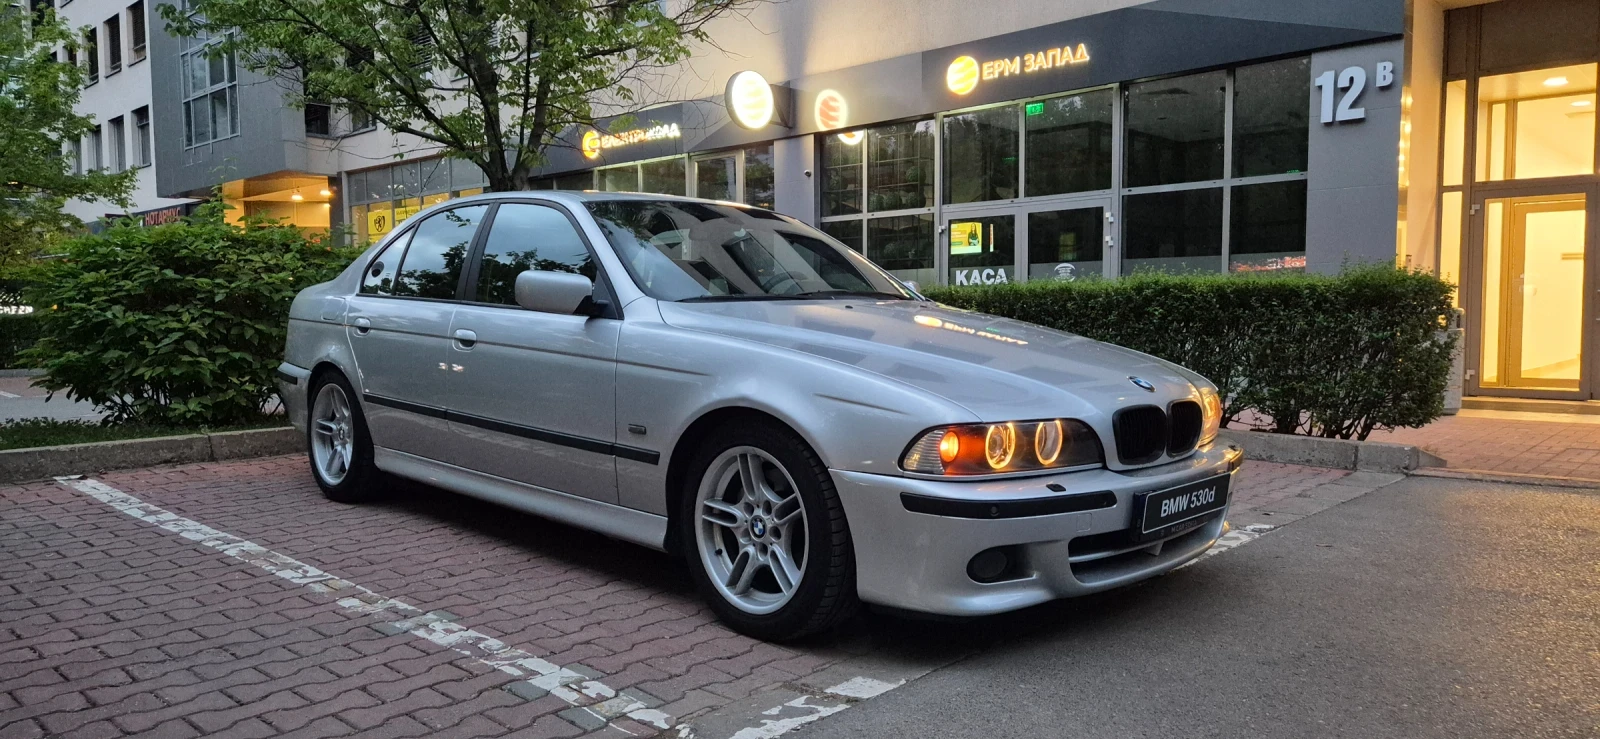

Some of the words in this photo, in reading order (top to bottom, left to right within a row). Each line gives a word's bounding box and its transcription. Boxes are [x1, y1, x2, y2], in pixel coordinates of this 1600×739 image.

[981, 56, 1020, 80] ЕРМ
[1023, 43, 1089, 72] ЗАПАД
[1314, 66, 1367, 124] 12
[955, 268, 1008, 286] КАСА
[1160, 493, 1190, 518] BMW
[1190, 486, 1216, 508] 530d
